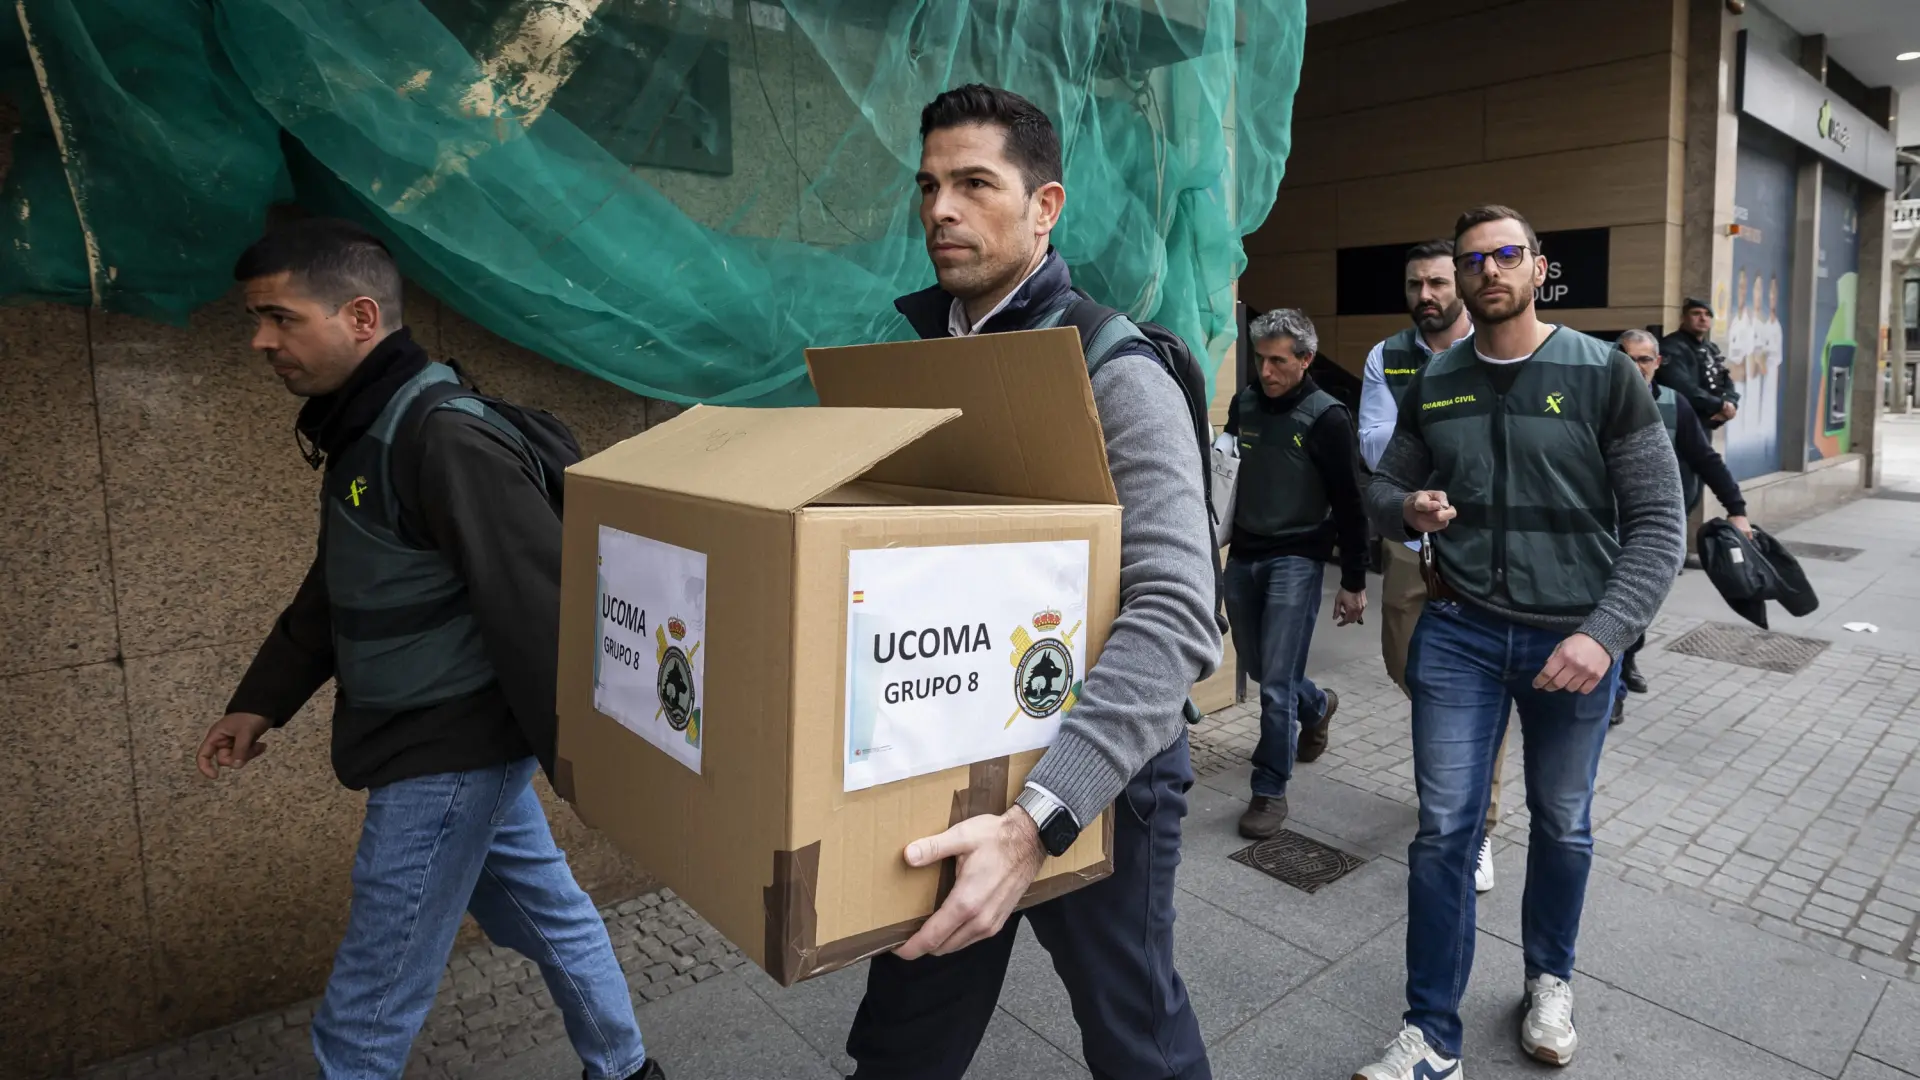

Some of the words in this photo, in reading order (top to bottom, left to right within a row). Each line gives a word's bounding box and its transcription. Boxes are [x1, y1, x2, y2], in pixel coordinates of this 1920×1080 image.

[1548, 262, 1562, 279] S
[1422, 399, 1453, 411] GUARDIA
[1454, 394, 1476, 404] CIVIL
[602, 592, 646, 638] UCOMA
[604, 636, 632, 666] GRUPO
[633, 651, 640, 671] 8
[873, 622, 992, 664] UCOMA
[884, 674, 962, 705] GRUPO
[967, 671, 979, 692] 8
